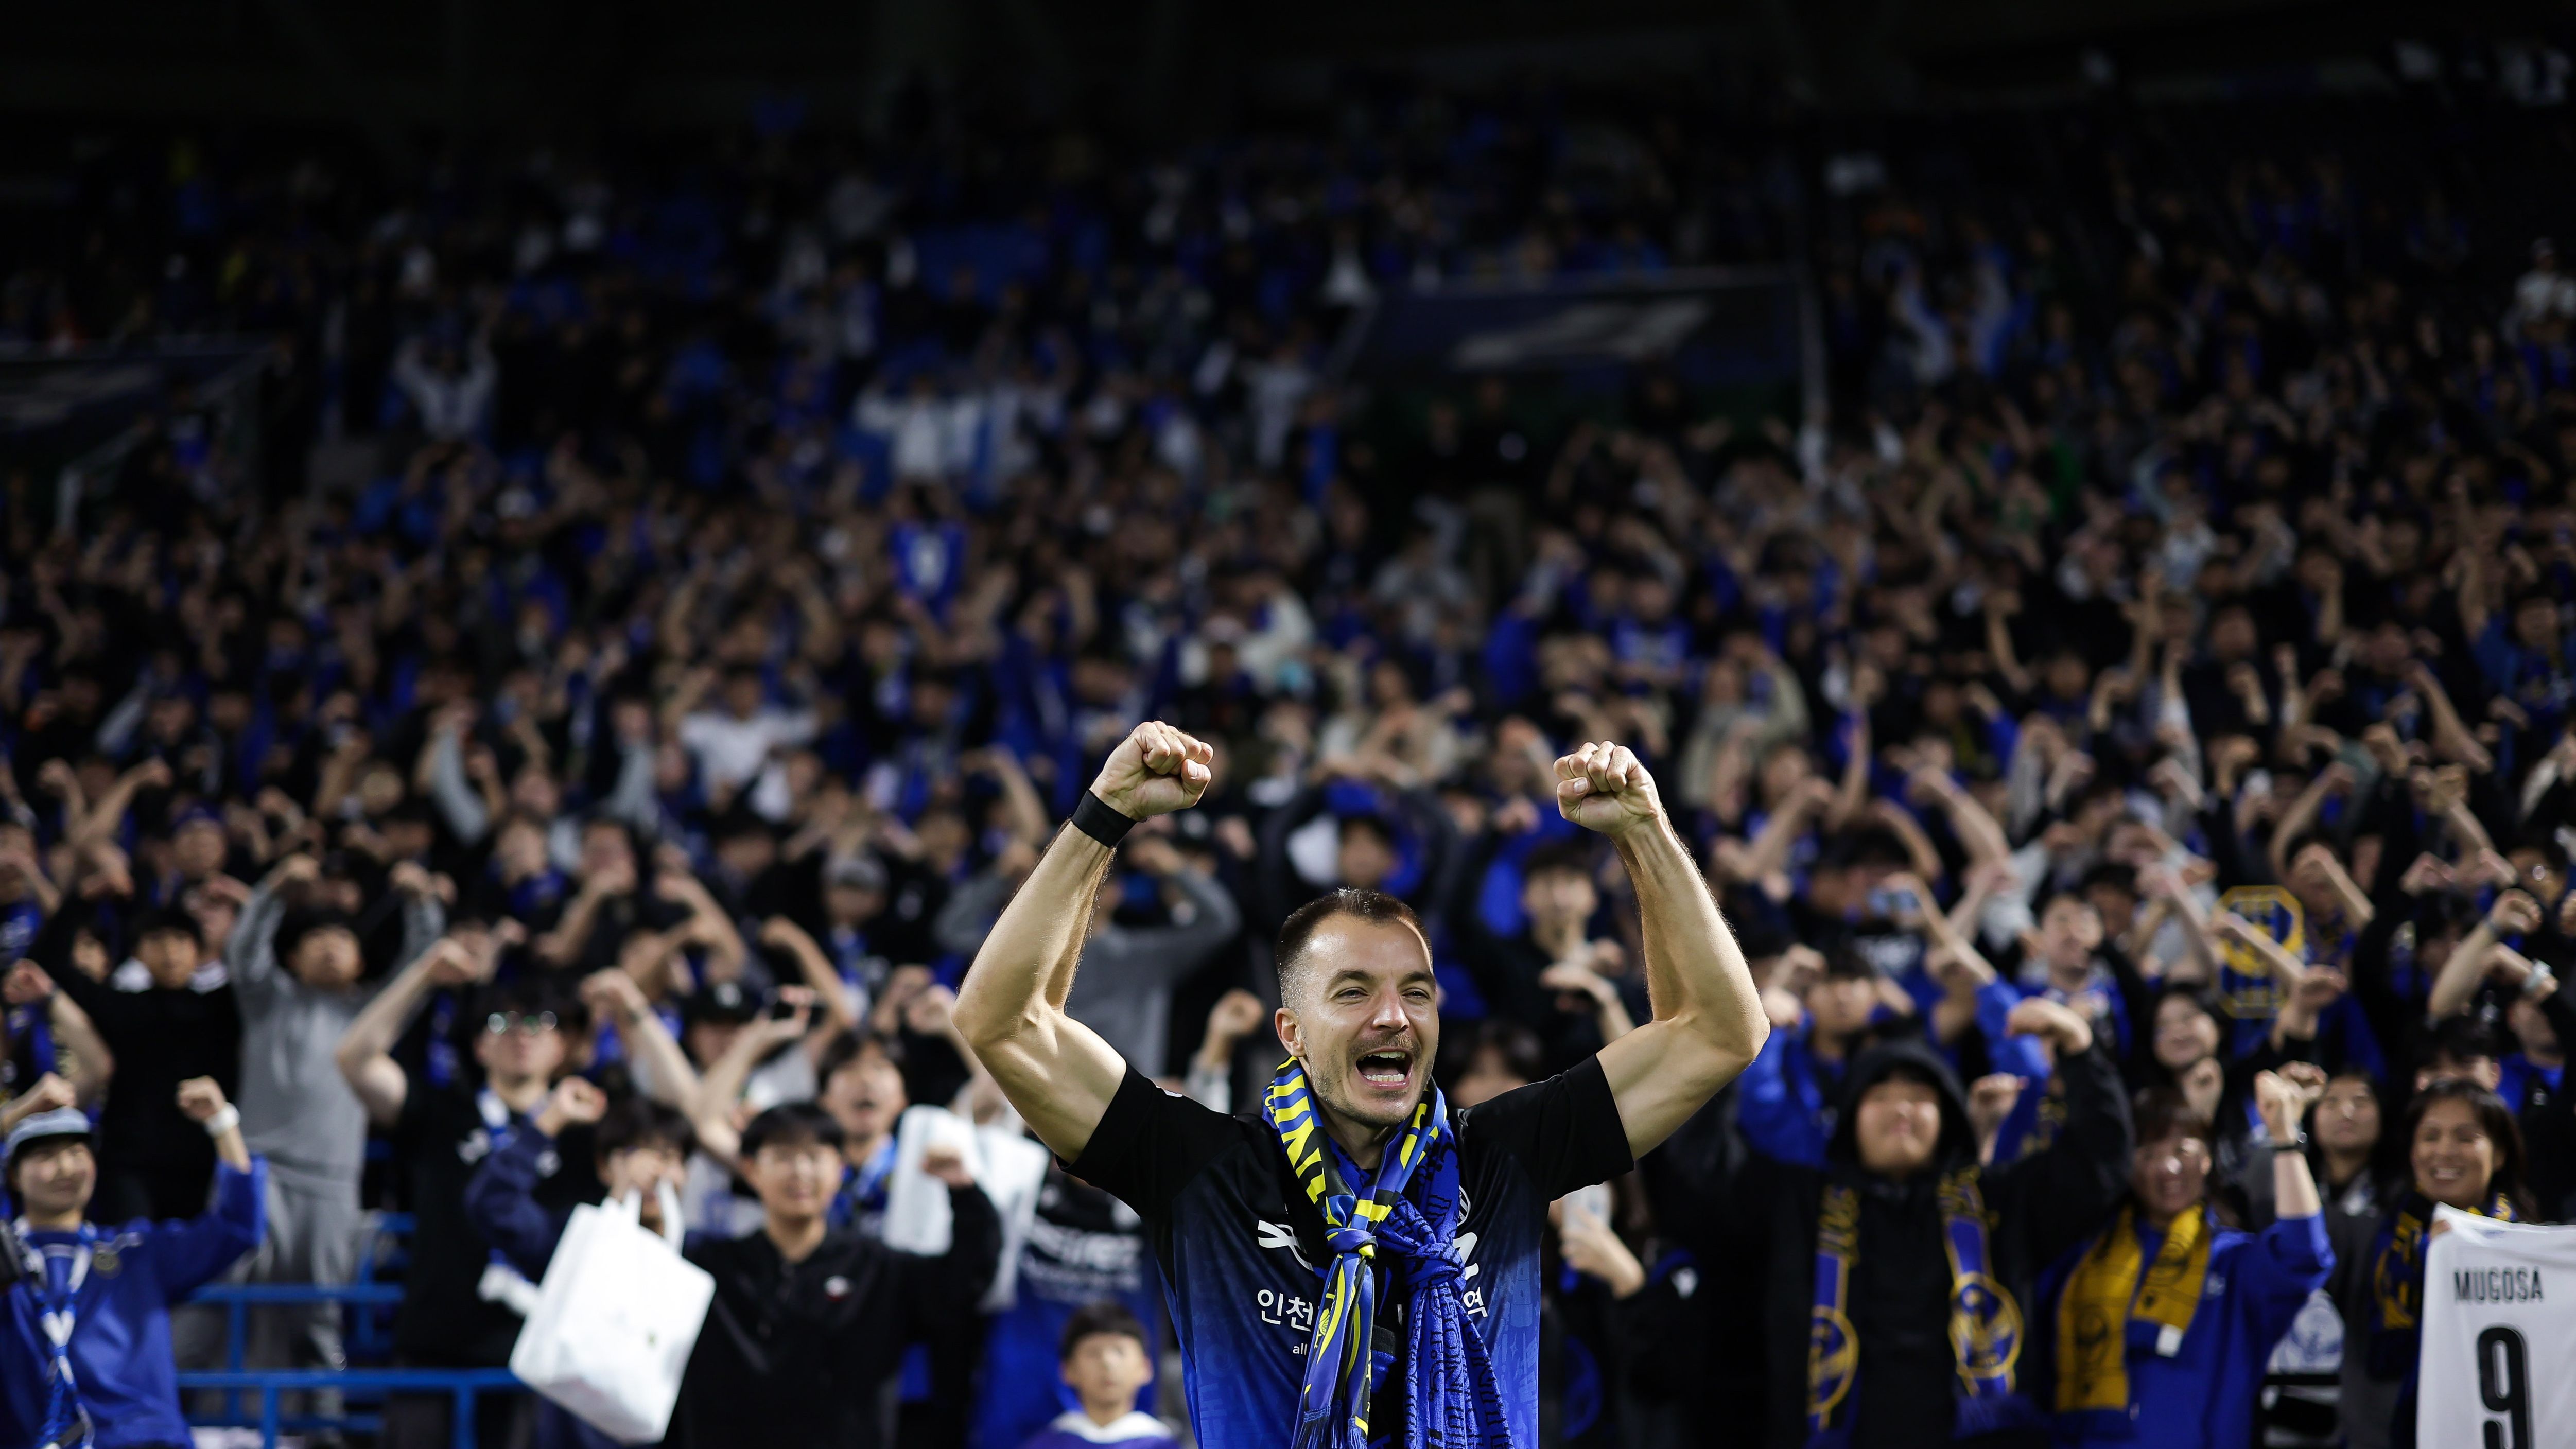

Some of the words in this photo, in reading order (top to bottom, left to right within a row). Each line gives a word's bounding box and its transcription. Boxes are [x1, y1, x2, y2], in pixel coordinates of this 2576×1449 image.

[2454, 1269, 2543, 1301] MUGOSA
[1257, 1289, 1313, 1332] 인천
[1292, 1342, 1308, 1355] all
[2477, 1325, 2530, 1449] 9
